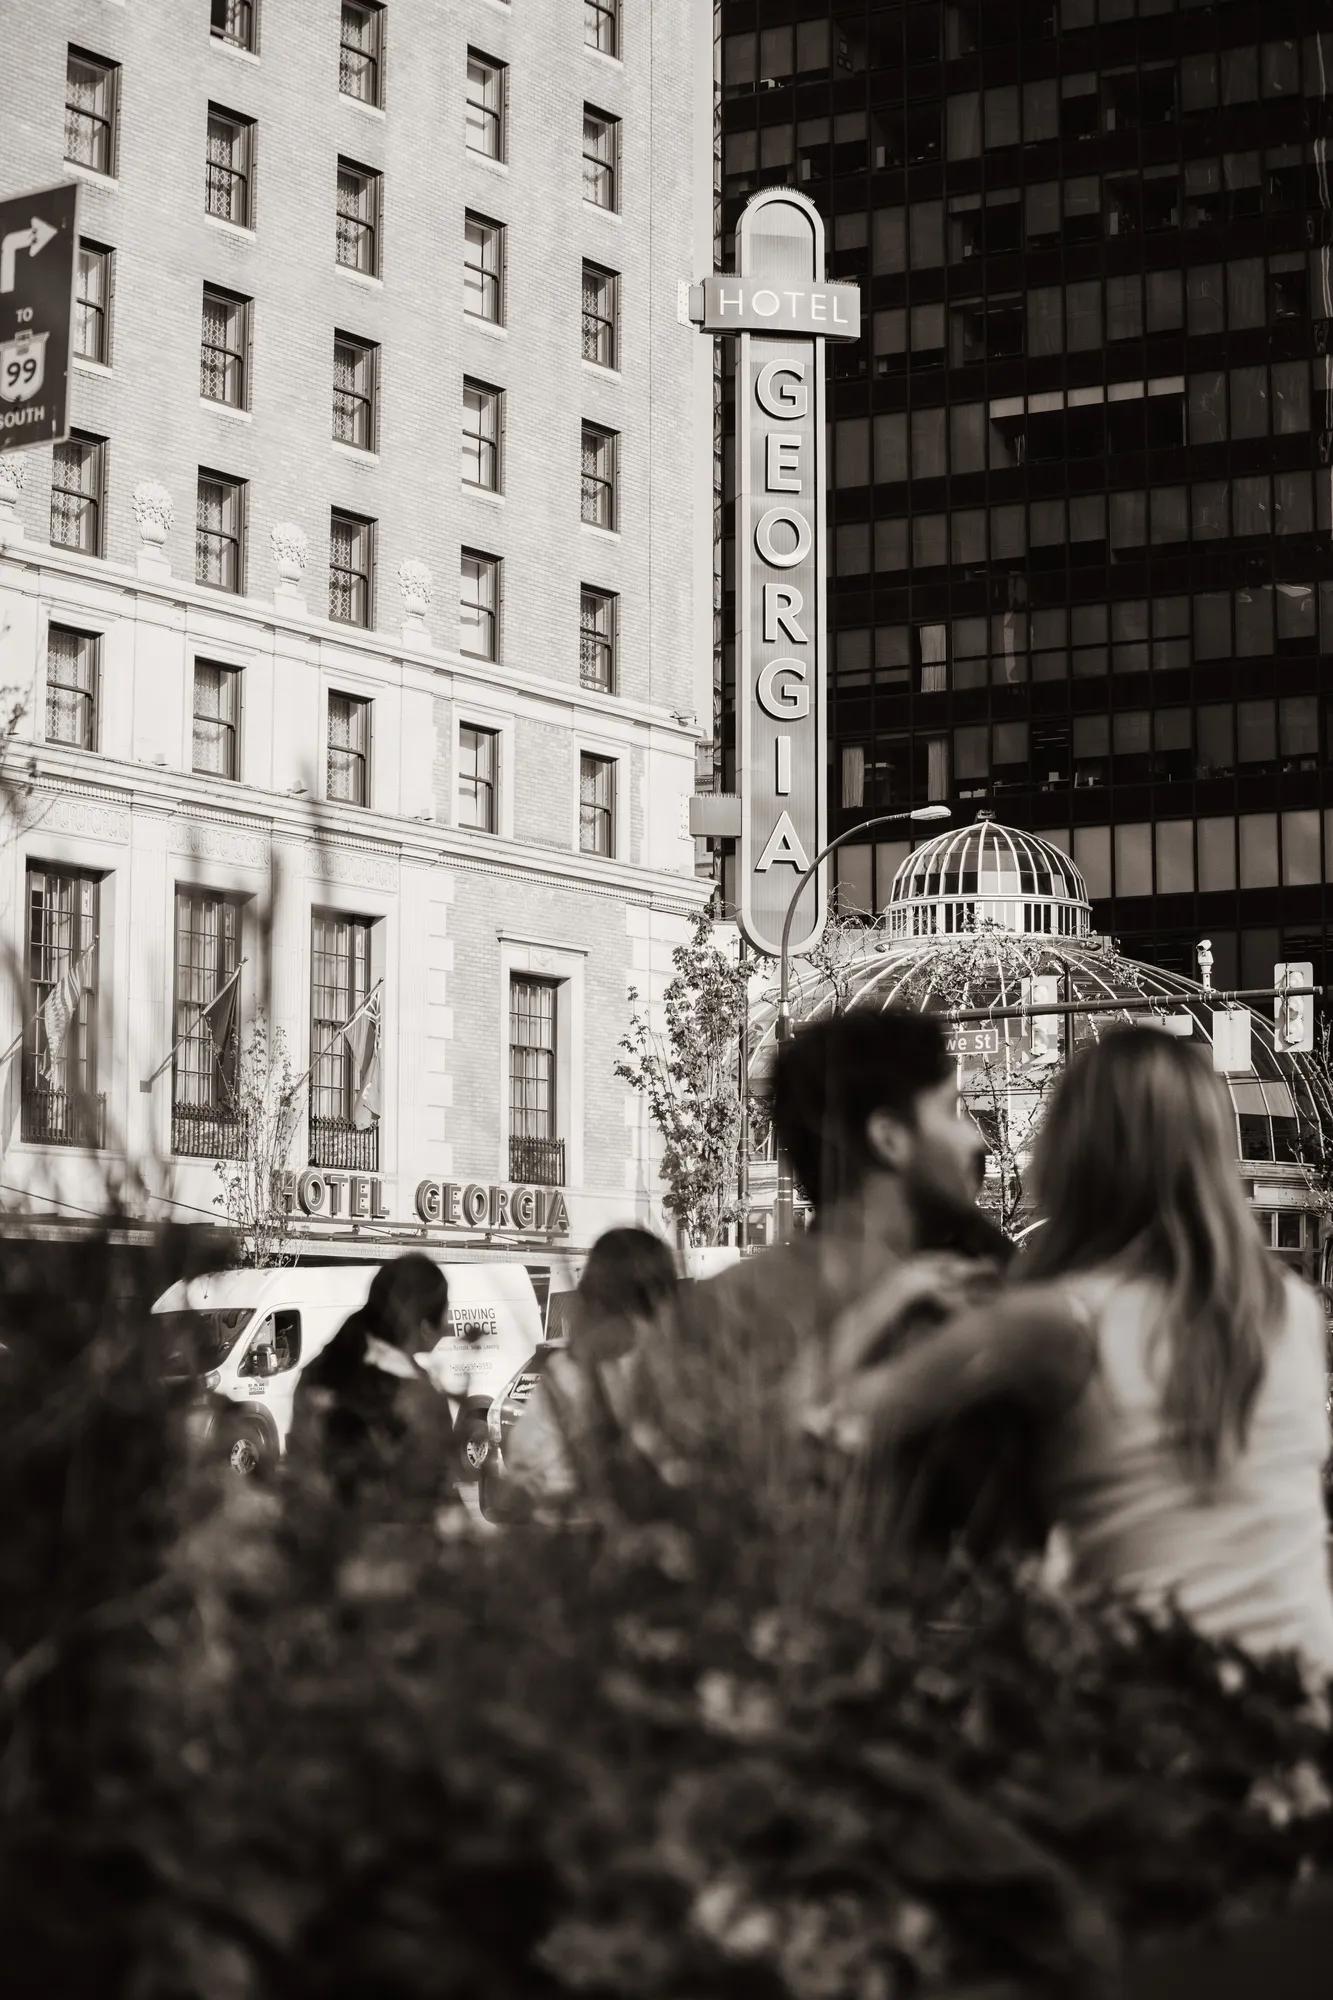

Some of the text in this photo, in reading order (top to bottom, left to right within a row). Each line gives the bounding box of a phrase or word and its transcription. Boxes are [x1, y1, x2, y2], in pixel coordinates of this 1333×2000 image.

[16, 307, 33, 322] TO
[720, 289, 849, 323] HOTEL
[7, 359, 37, 387] 99
[755, 358, 812, 872] GEORGIA
[945, 1033, 991, 1051] we St
[271, 1170, 570, 1231] HOTEL GEORGIA
[454, 1308, 495, 1320] DRIVING
